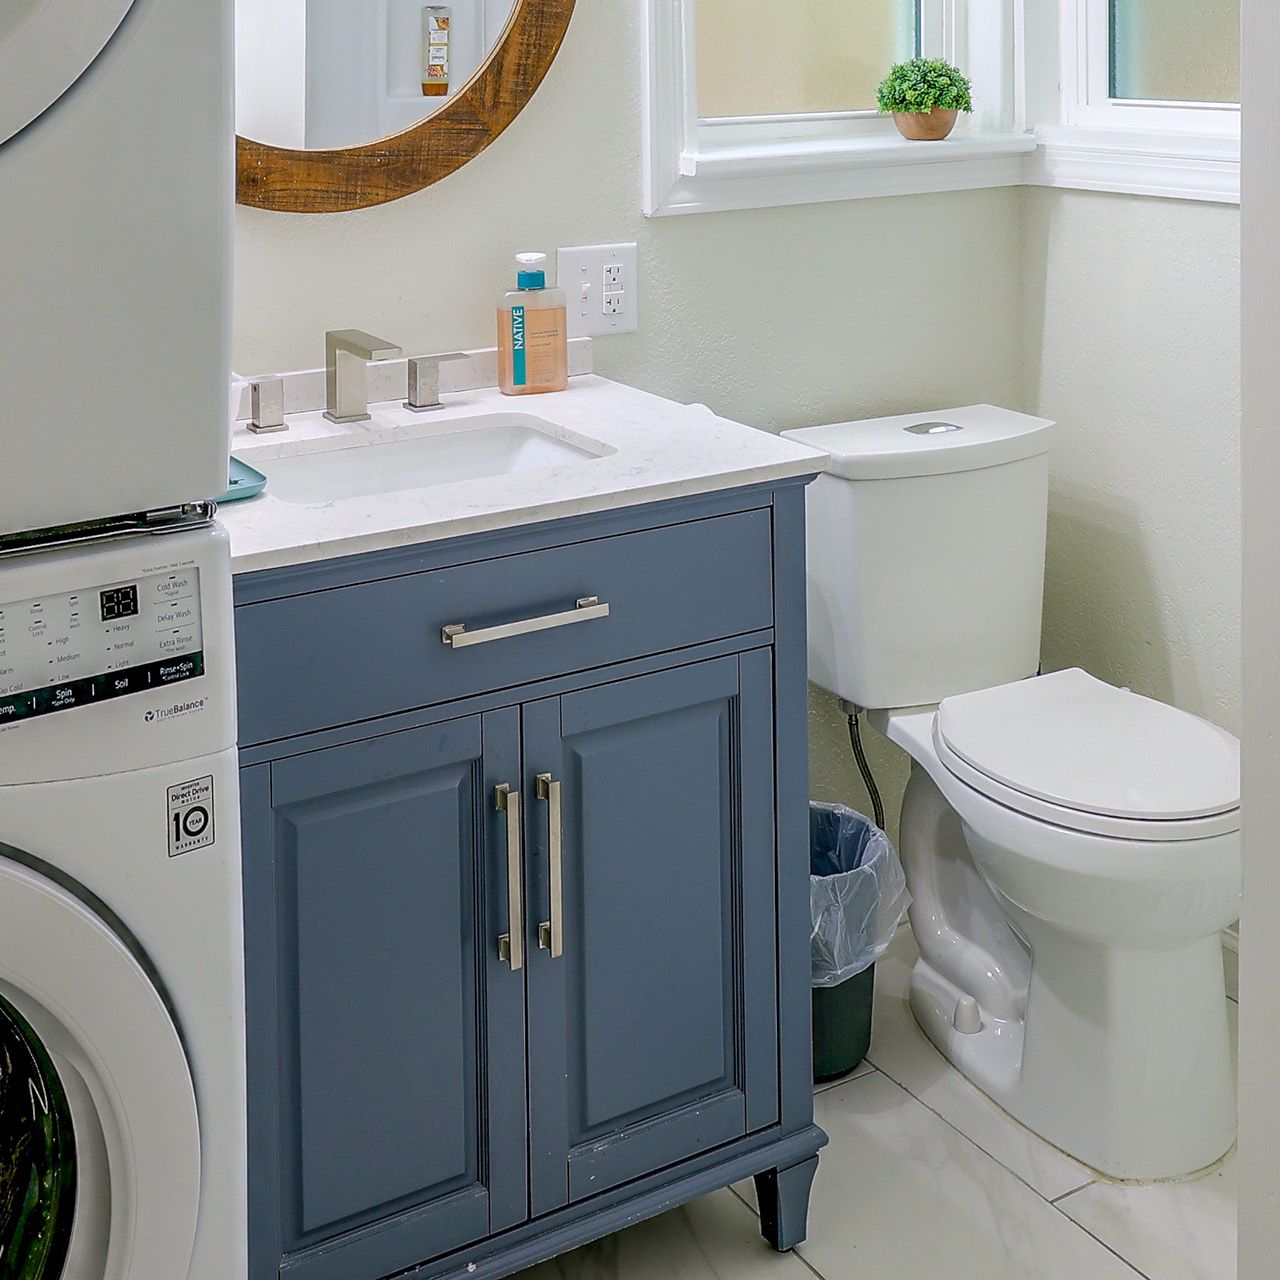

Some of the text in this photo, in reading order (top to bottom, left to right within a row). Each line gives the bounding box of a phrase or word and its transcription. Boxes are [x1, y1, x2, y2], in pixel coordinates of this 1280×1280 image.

[513, 309, 524, 350] NATIVE
[156, 580, 188, 592] Cold Wash
[158, 610, 192, 624] Delay Wash
[113, 624, 130, 632] Heavy
[56, 636, 70, 646] High
[114, 640, 134, 650] Normal
[160, 635, 192, 649] Extra Rinse
[57, 652, 80, 663] Medium
[116, 659, 130, 668] Light
[9, 683, 23, 692] Cold
[115, 678, 128, 690] Soil
[56, 688, 72, 700] Spin
[171, 785, 210, 802] Direct Drive
[173, 806, 208, 842] 10
[189, 817, 203, 826] YEAR
[176, 836, 209, 850] WARRANTY
